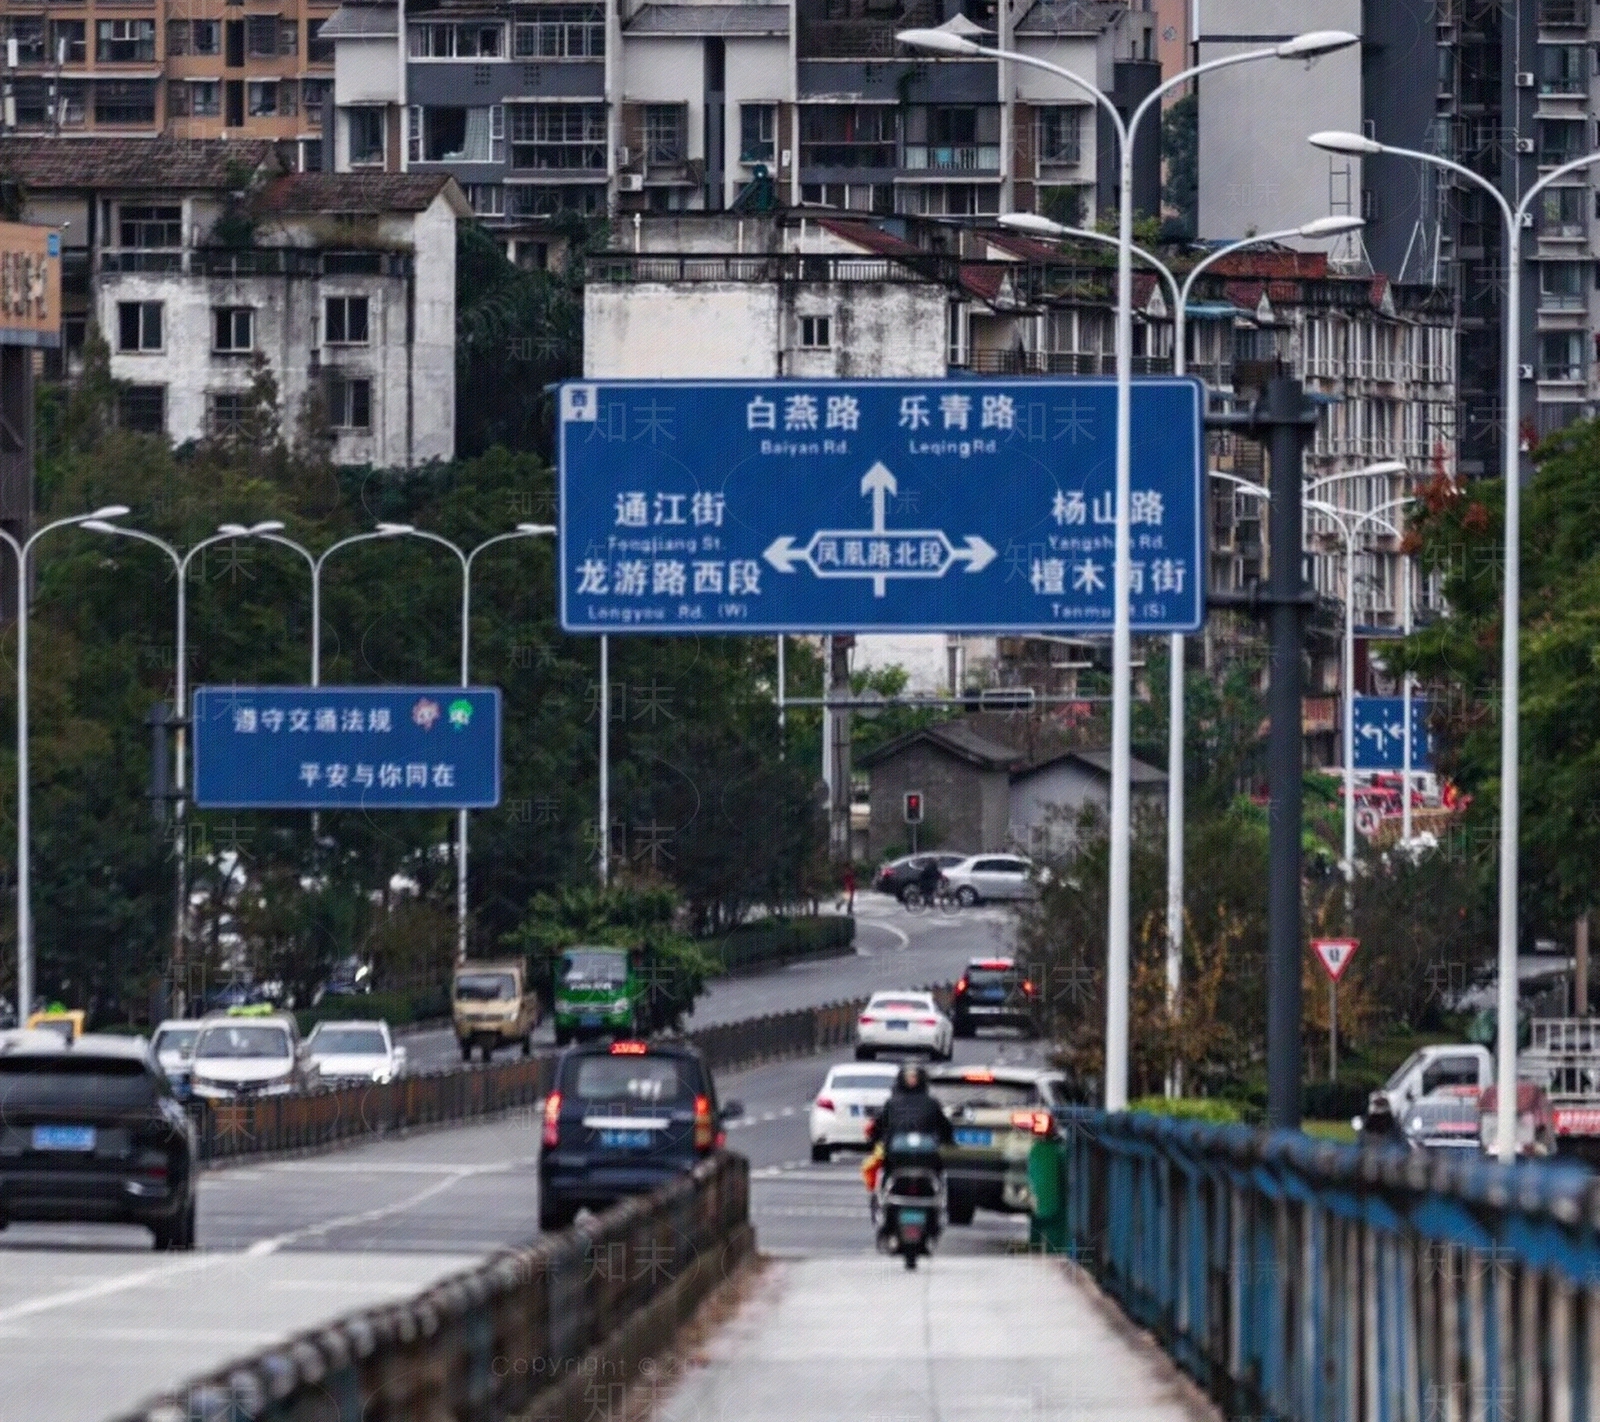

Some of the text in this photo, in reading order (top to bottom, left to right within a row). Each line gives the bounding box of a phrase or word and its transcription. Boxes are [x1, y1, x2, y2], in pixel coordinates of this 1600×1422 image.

[747, 394, 1013, 430] 白燕路 乐青路
[761, 439, 819, 456] Baiyan
[909, 439, 971, 458] Leqing
[615, 492, 725, 527] 通江街
[1052, 489, 1164, 526] 杨山路
[818, 540, 942, 567] 凤凰路北段
[576, 559, 762, 596] 龙游路西段
[718, 603, 748, 619] (W)
[234, 707, 392, 733] 遵守交通法规
[300, 762, 455, 788] 平安与你同在
